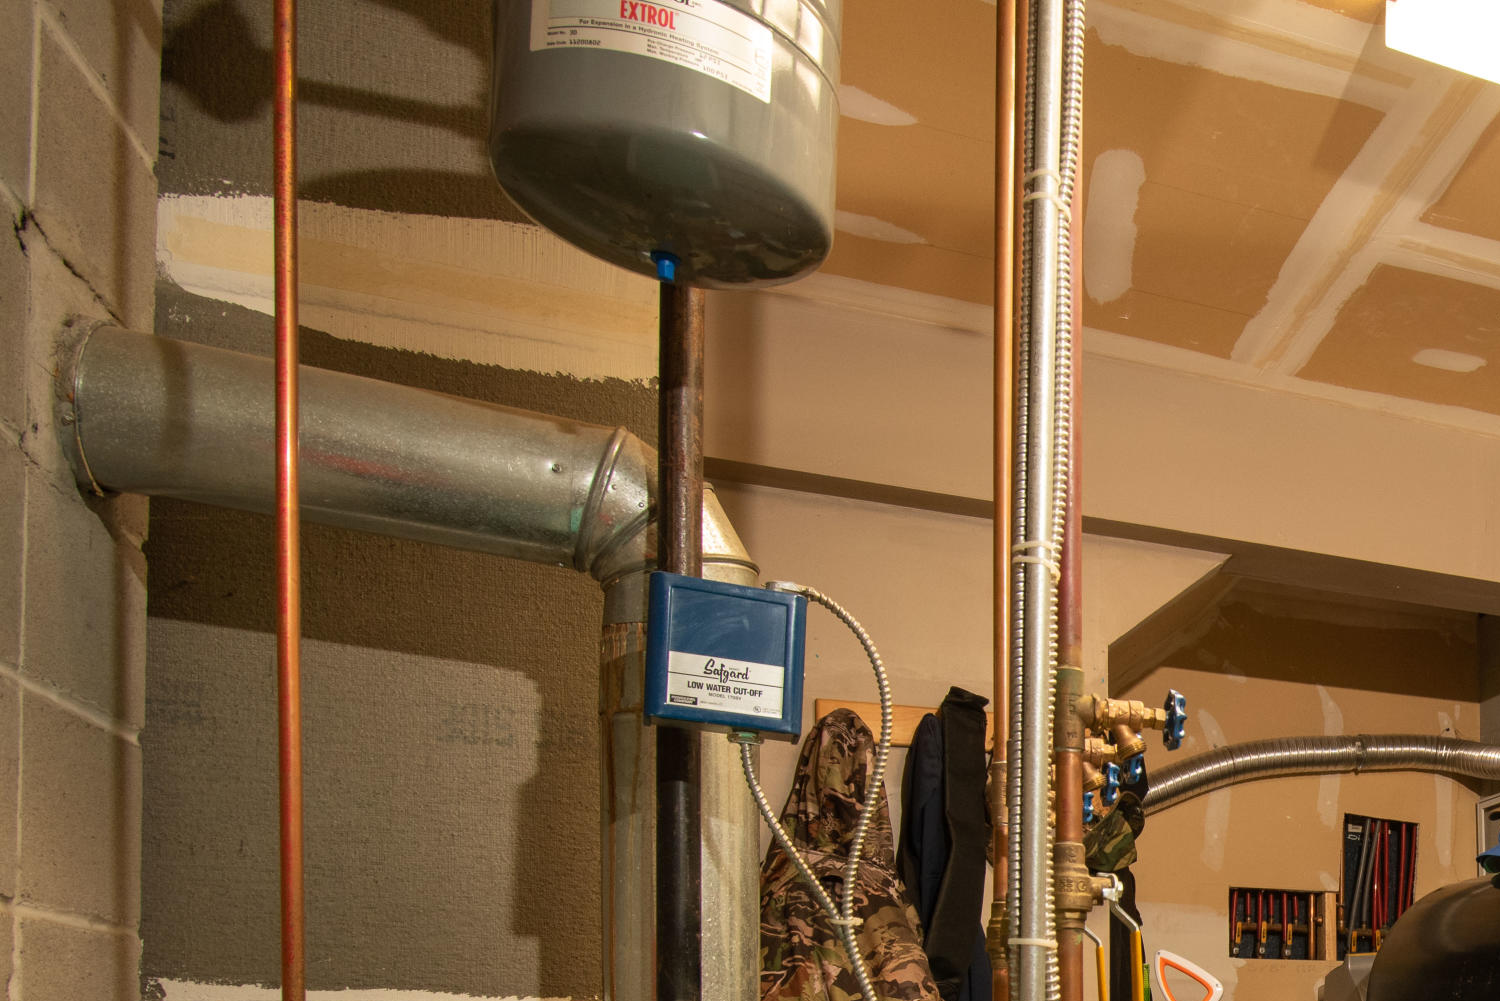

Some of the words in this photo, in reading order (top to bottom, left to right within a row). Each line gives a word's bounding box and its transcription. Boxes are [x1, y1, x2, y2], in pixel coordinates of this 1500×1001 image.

[620, 0, 676, 30] EXTROL
[704, 658, 750, 683] Safgard
[687, 681, 704, 690] LOW
[706, 683, 731, 693] WATER
[733, 687, 763, 697] CUT-OFF
